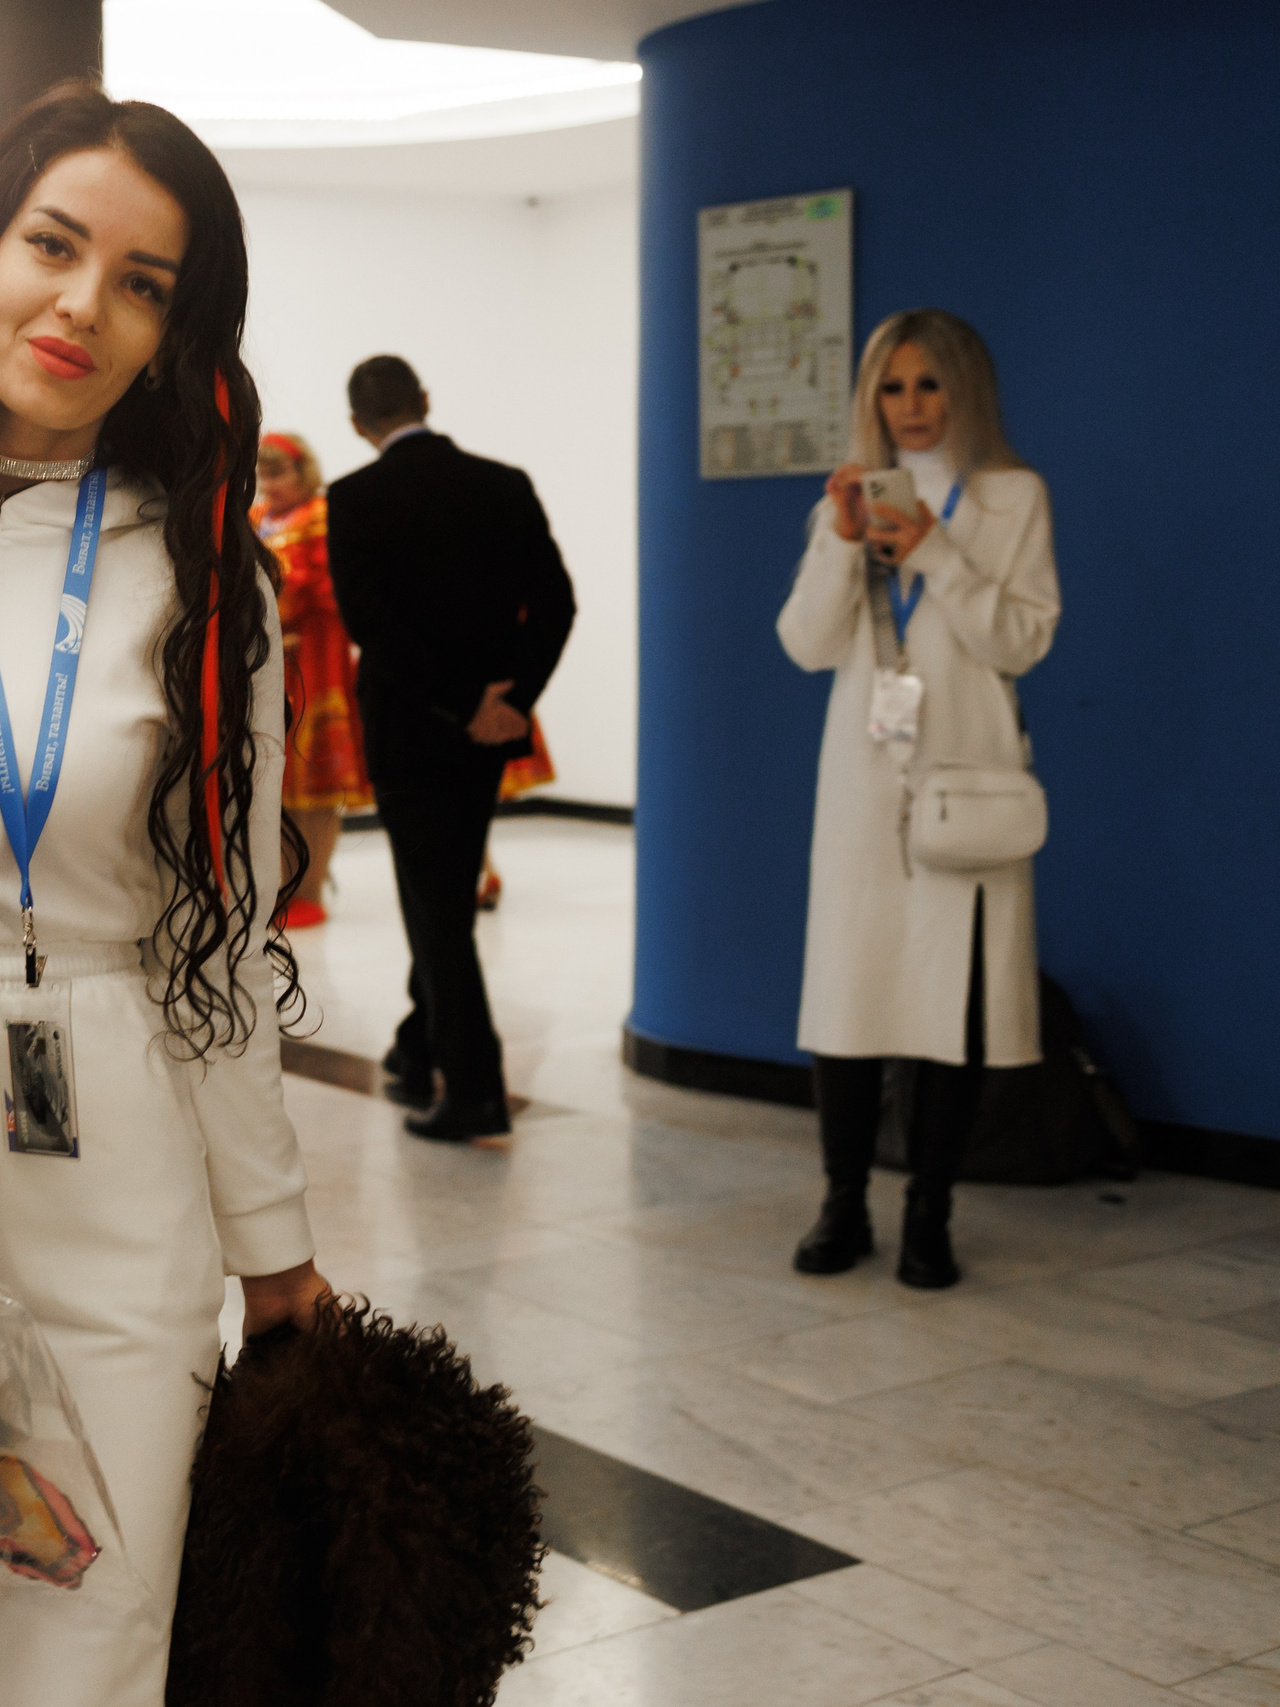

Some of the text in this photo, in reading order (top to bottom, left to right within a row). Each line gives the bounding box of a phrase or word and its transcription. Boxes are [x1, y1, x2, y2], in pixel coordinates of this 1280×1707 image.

[72, 532, 93, 575] Виват,
[35, 672, 69, 792] Виват, таланты!
